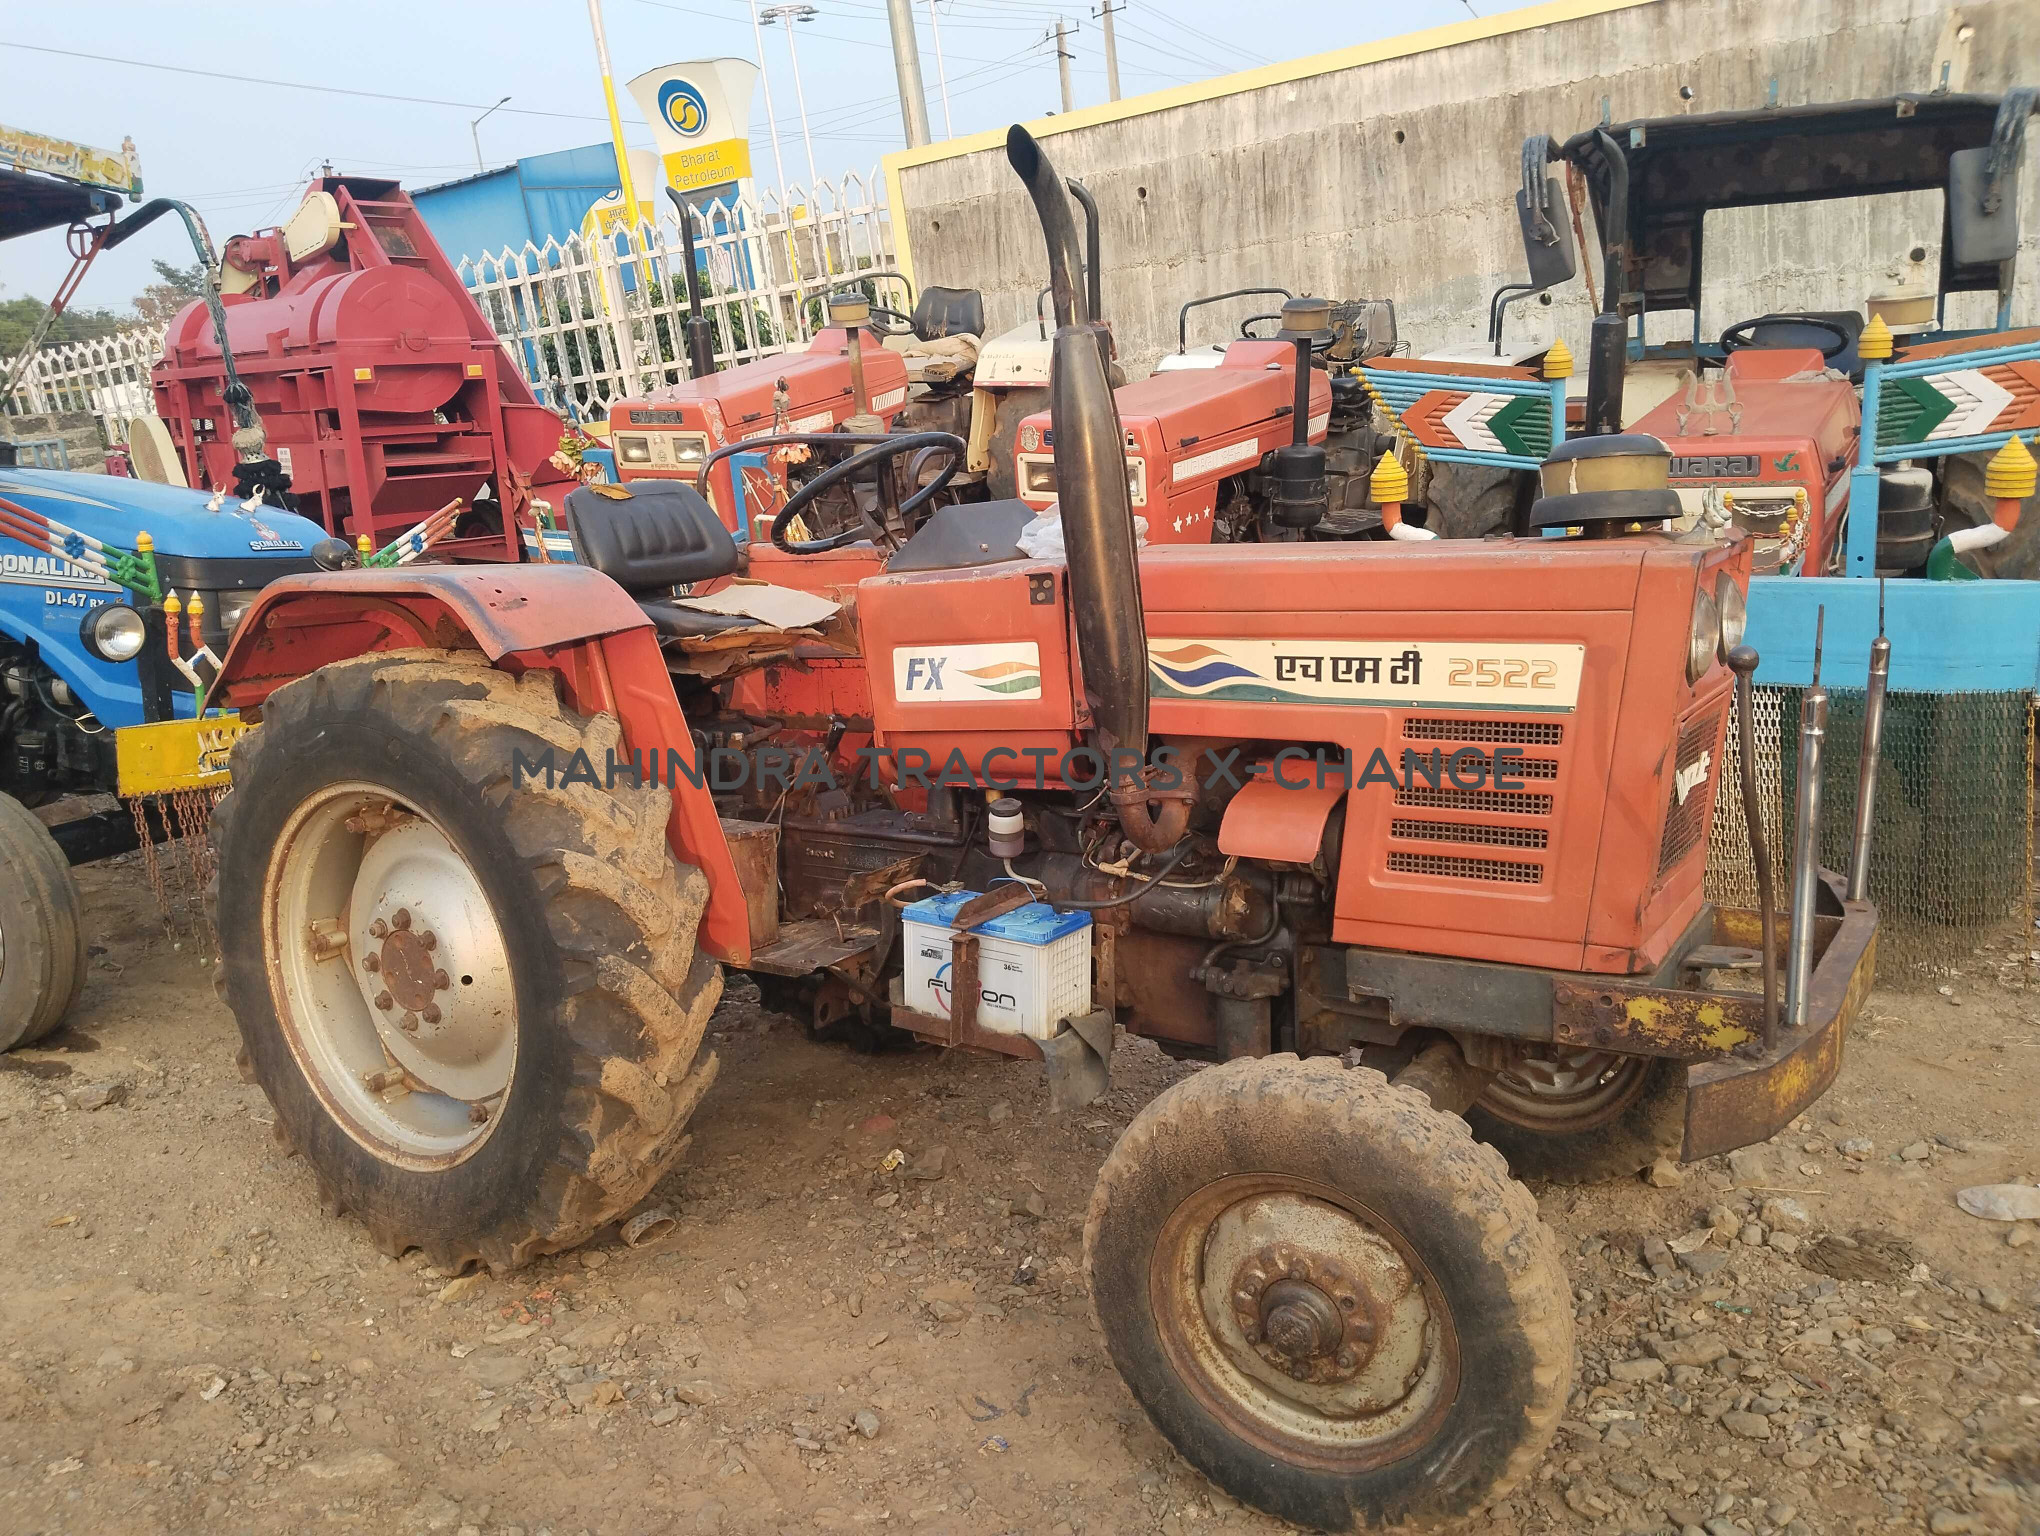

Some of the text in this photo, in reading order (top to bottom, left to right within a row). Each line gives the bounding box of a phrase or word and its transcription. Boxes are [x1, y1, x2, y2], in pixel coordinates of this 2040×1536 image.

[681, 149, 721, 169] Bharat
[674, 164, 735, 188] Petroleum
[249, 540, 303, 551] SONALIKA
[45, 590, 87, 607] DI-47
[905, 656, 948, 691] FX
[1274, 650, 1558, 689] एच एम टी 2522
